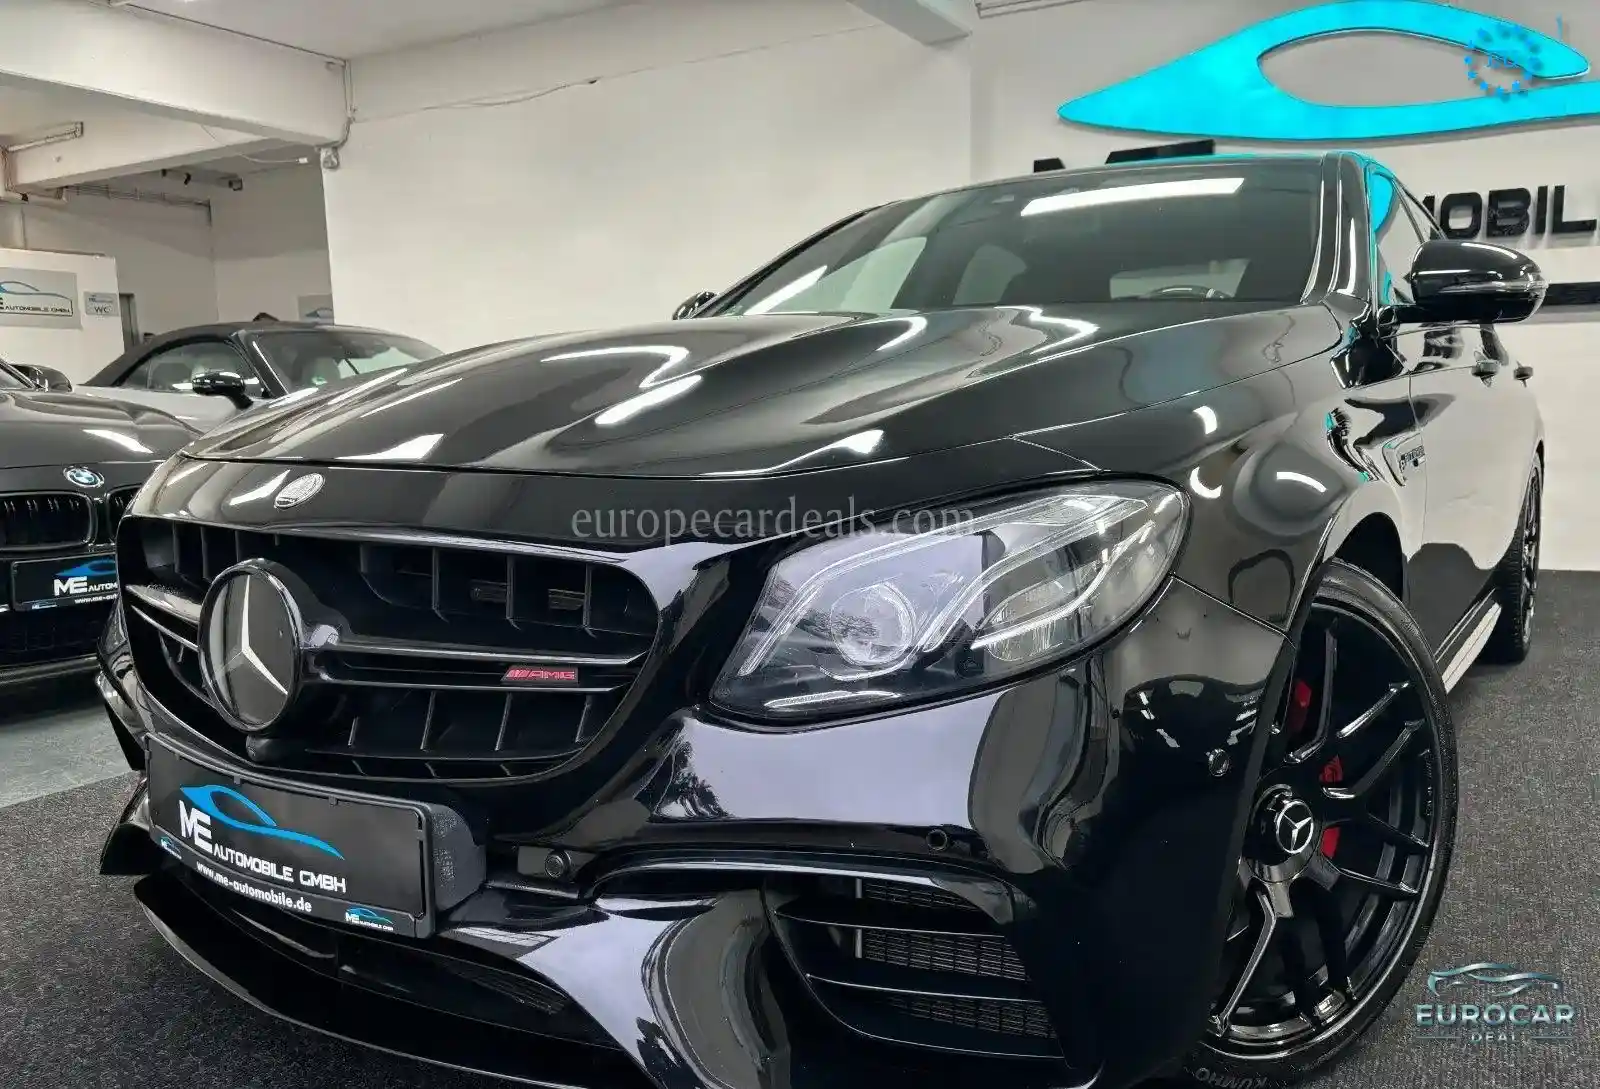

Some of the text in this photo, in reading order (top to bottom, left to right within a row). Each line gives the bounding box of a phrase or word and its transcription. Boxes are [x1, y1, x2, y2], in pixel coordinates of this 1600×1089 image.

[94, 305, 112, 314] WC
[54, 576, 118, 596] ME AUTOM
[75, 593, 118, 604] www.me-aut
[179, 800, 213, 853] ME
[213, 843, 294, 883] AUTOMOBILE
[300, 870, 346, 893] GMBH
[196, 861, 312, 913] www.me-automobile.de
